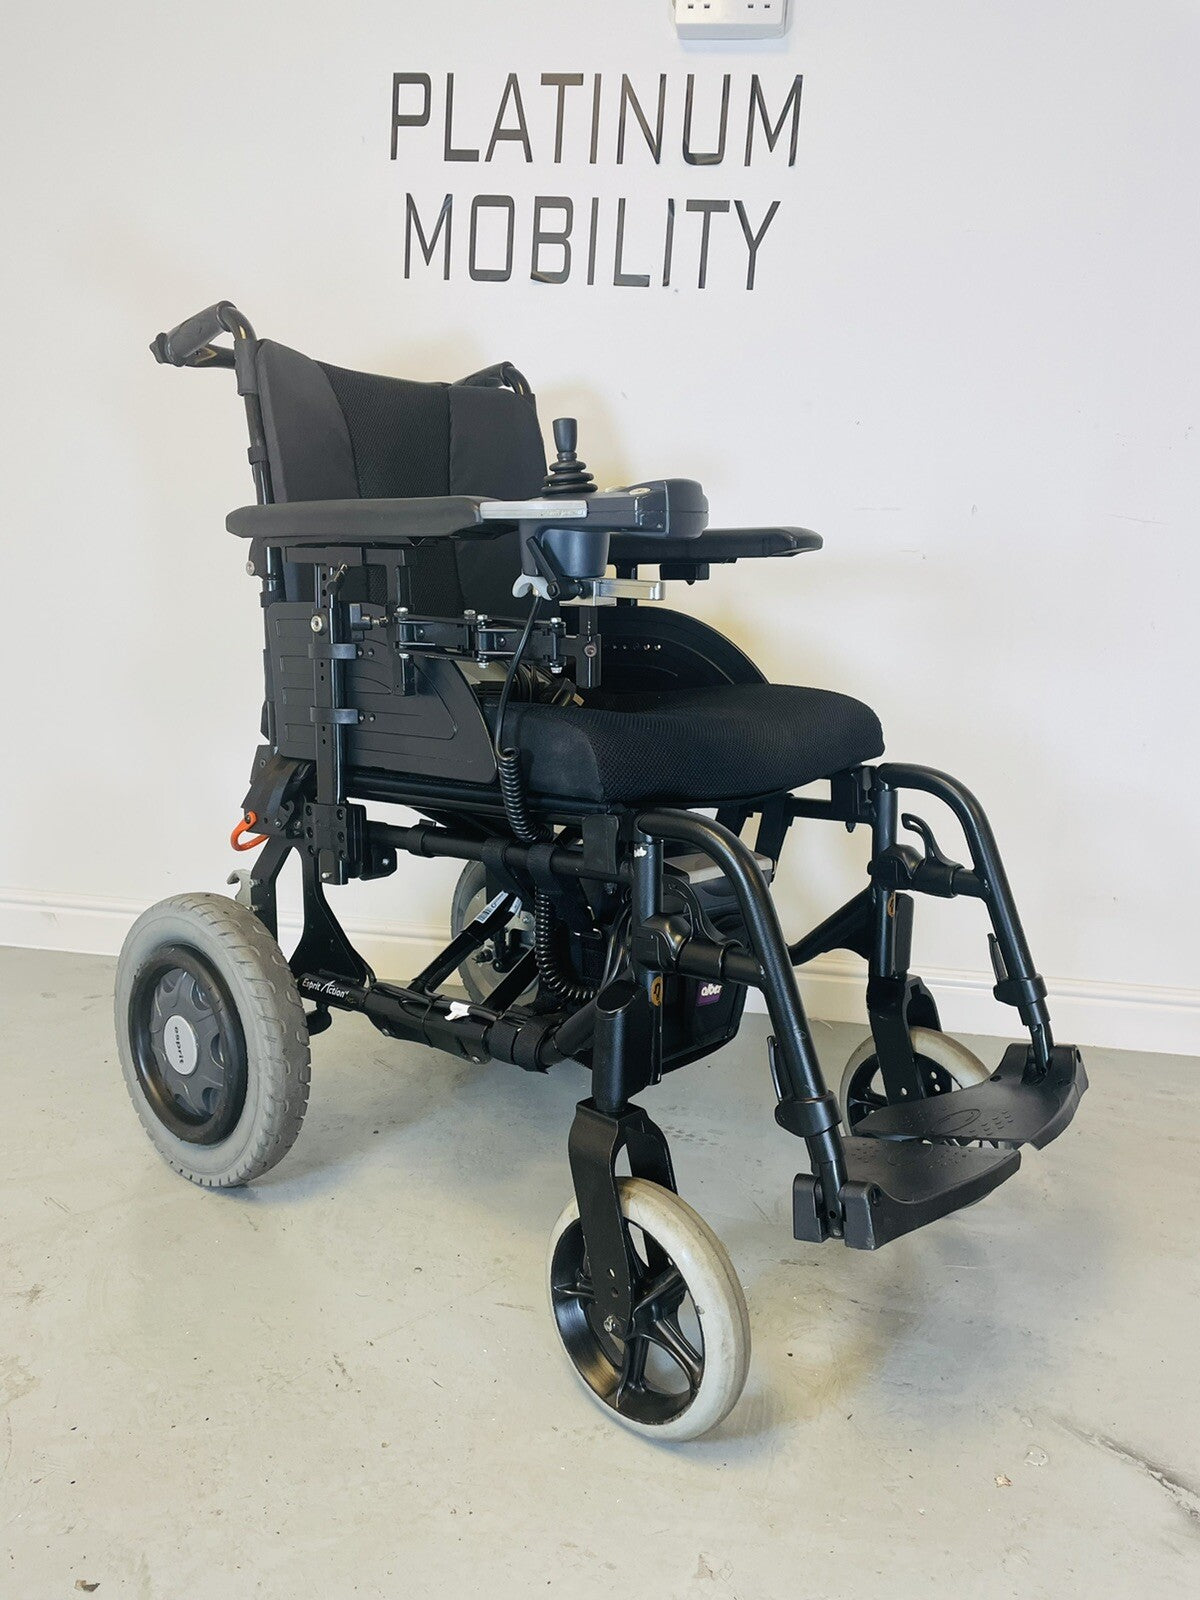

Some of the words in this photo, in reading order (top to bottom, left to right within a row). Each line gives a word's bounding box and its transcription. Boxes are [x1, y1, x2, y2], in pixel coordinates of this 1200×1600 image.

[391, 72, 803, 167] PLATINUM
[404, 192, 781, 291] MOBILITY
[301, 977, 321, 991] Esprit
